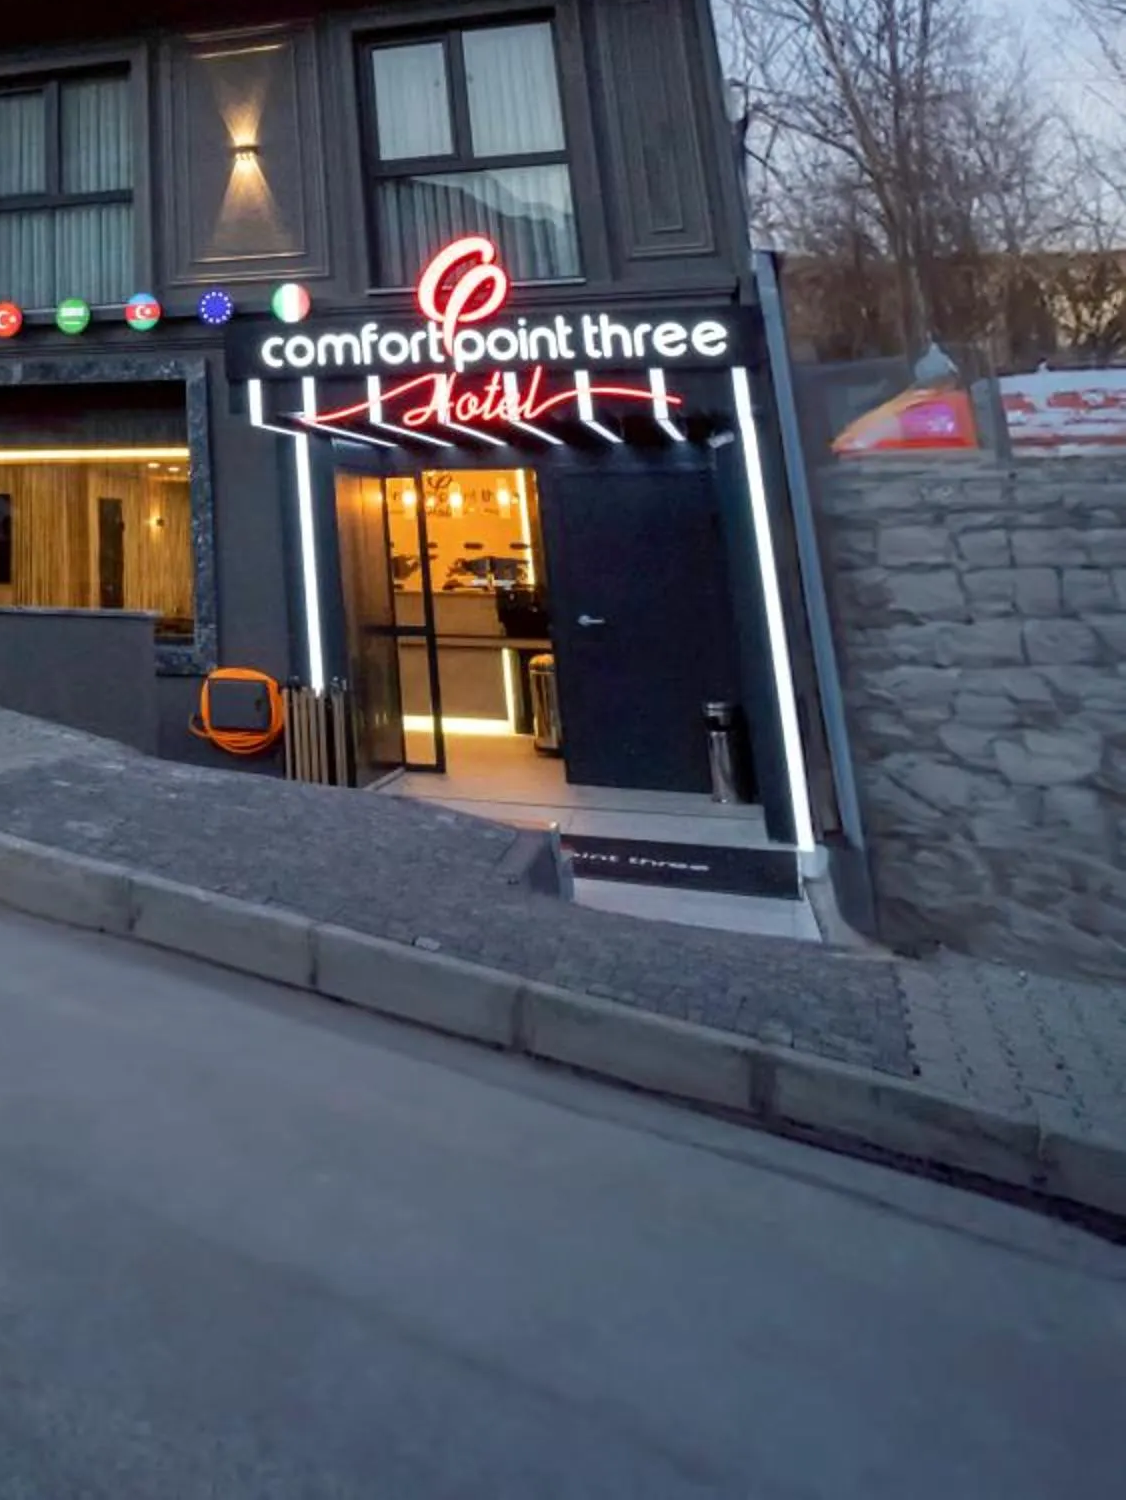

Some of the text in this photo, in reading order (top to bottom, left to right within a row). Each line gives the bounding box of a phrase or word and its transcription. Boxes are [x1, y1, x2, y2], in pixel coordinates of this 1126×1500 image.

[261, 314, 728, 372] comfort point three
